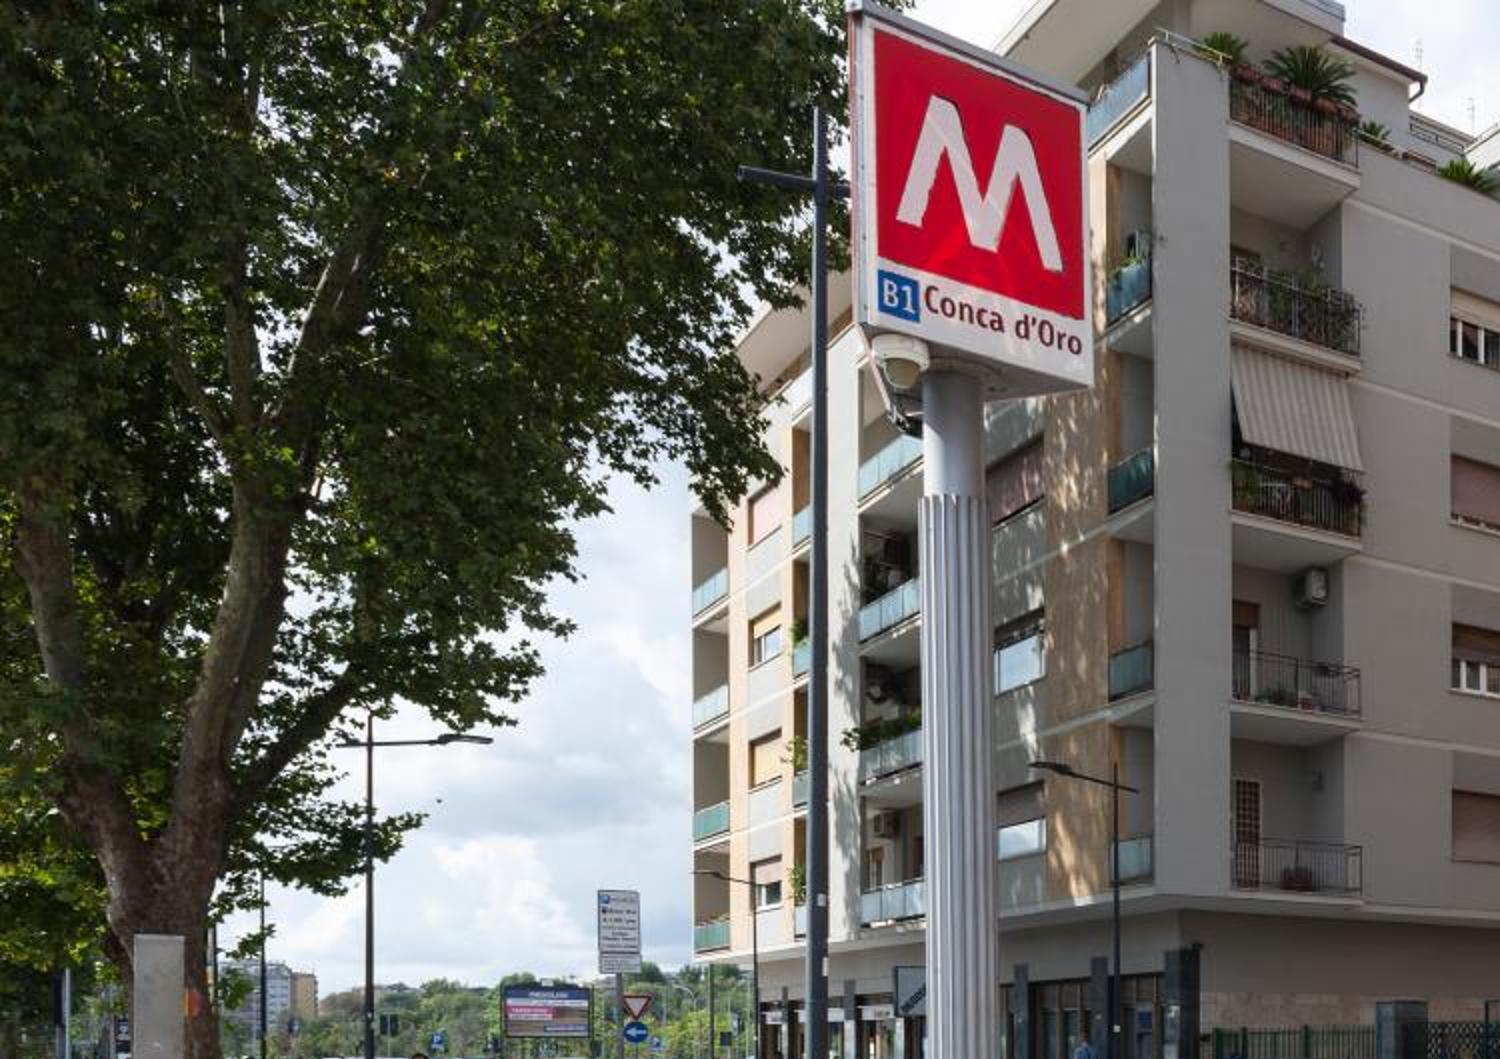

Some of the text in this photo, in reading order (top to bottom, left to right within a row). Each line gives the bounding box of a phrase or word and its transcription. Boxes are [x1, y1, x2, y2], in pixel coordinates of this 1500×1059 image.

[896, 94, 1063, 272] M
[883, 278, 1083, 356] B1 Conca d'Oro
